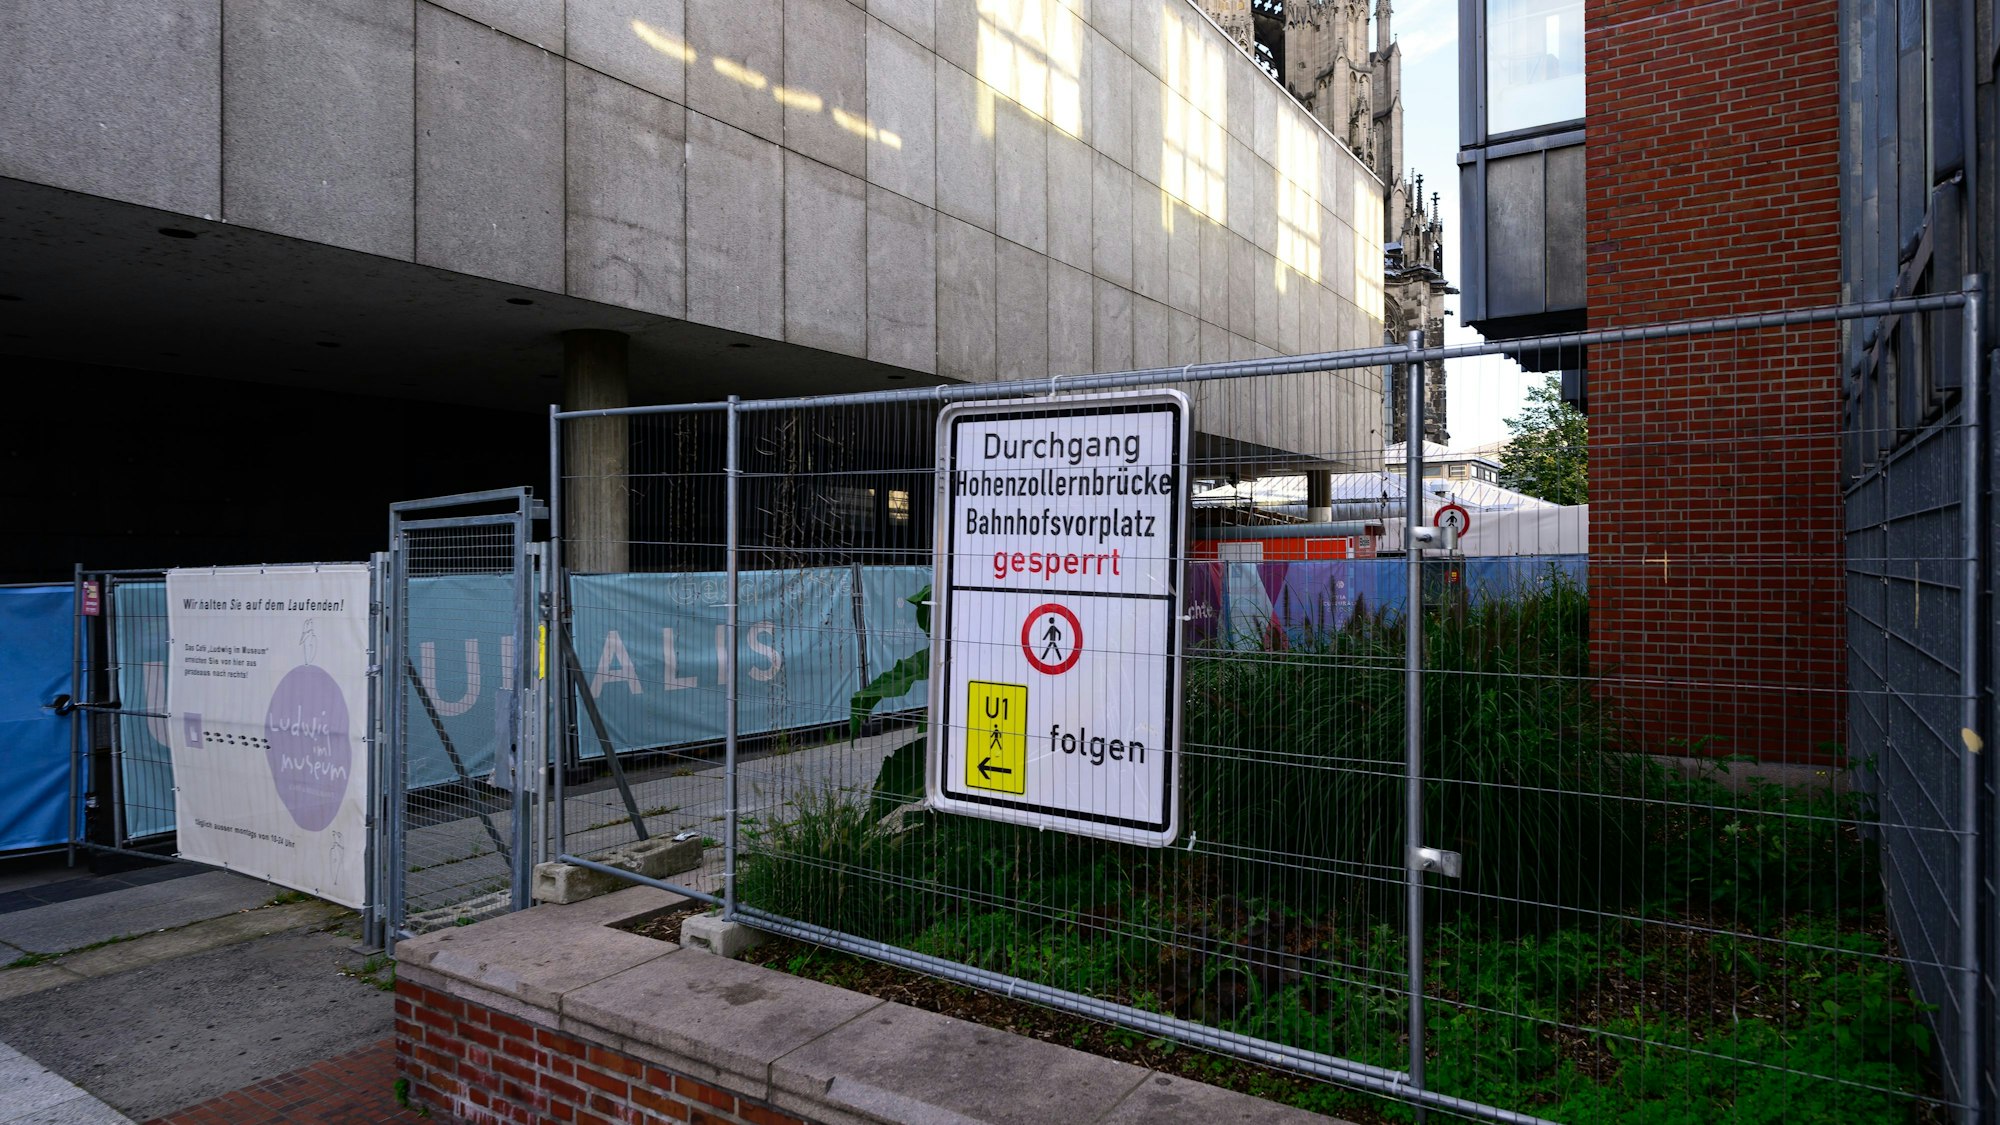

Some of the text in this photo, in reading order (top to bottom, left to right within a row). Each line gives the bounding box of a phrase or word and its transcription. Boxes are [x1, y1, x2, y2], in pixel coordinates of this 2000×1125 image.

[984, 431, 1140, 465] Durchgang
[956, 466, 1172, 497] Hohenzollernbrücke
[966, 507, 1156, 544] Bahnhofsvorplatz
[993, 548, 1120, 581] gesperrt
[183, 598, 345, 612] Wir halten Sie auf dem Laufenden!
[208, 657, 219, 665] Sie
[985, 695, 1008, 720] U1
[269, 705, 331, 757] Ludwig
[1050, 724, 1144, 766] folgen
